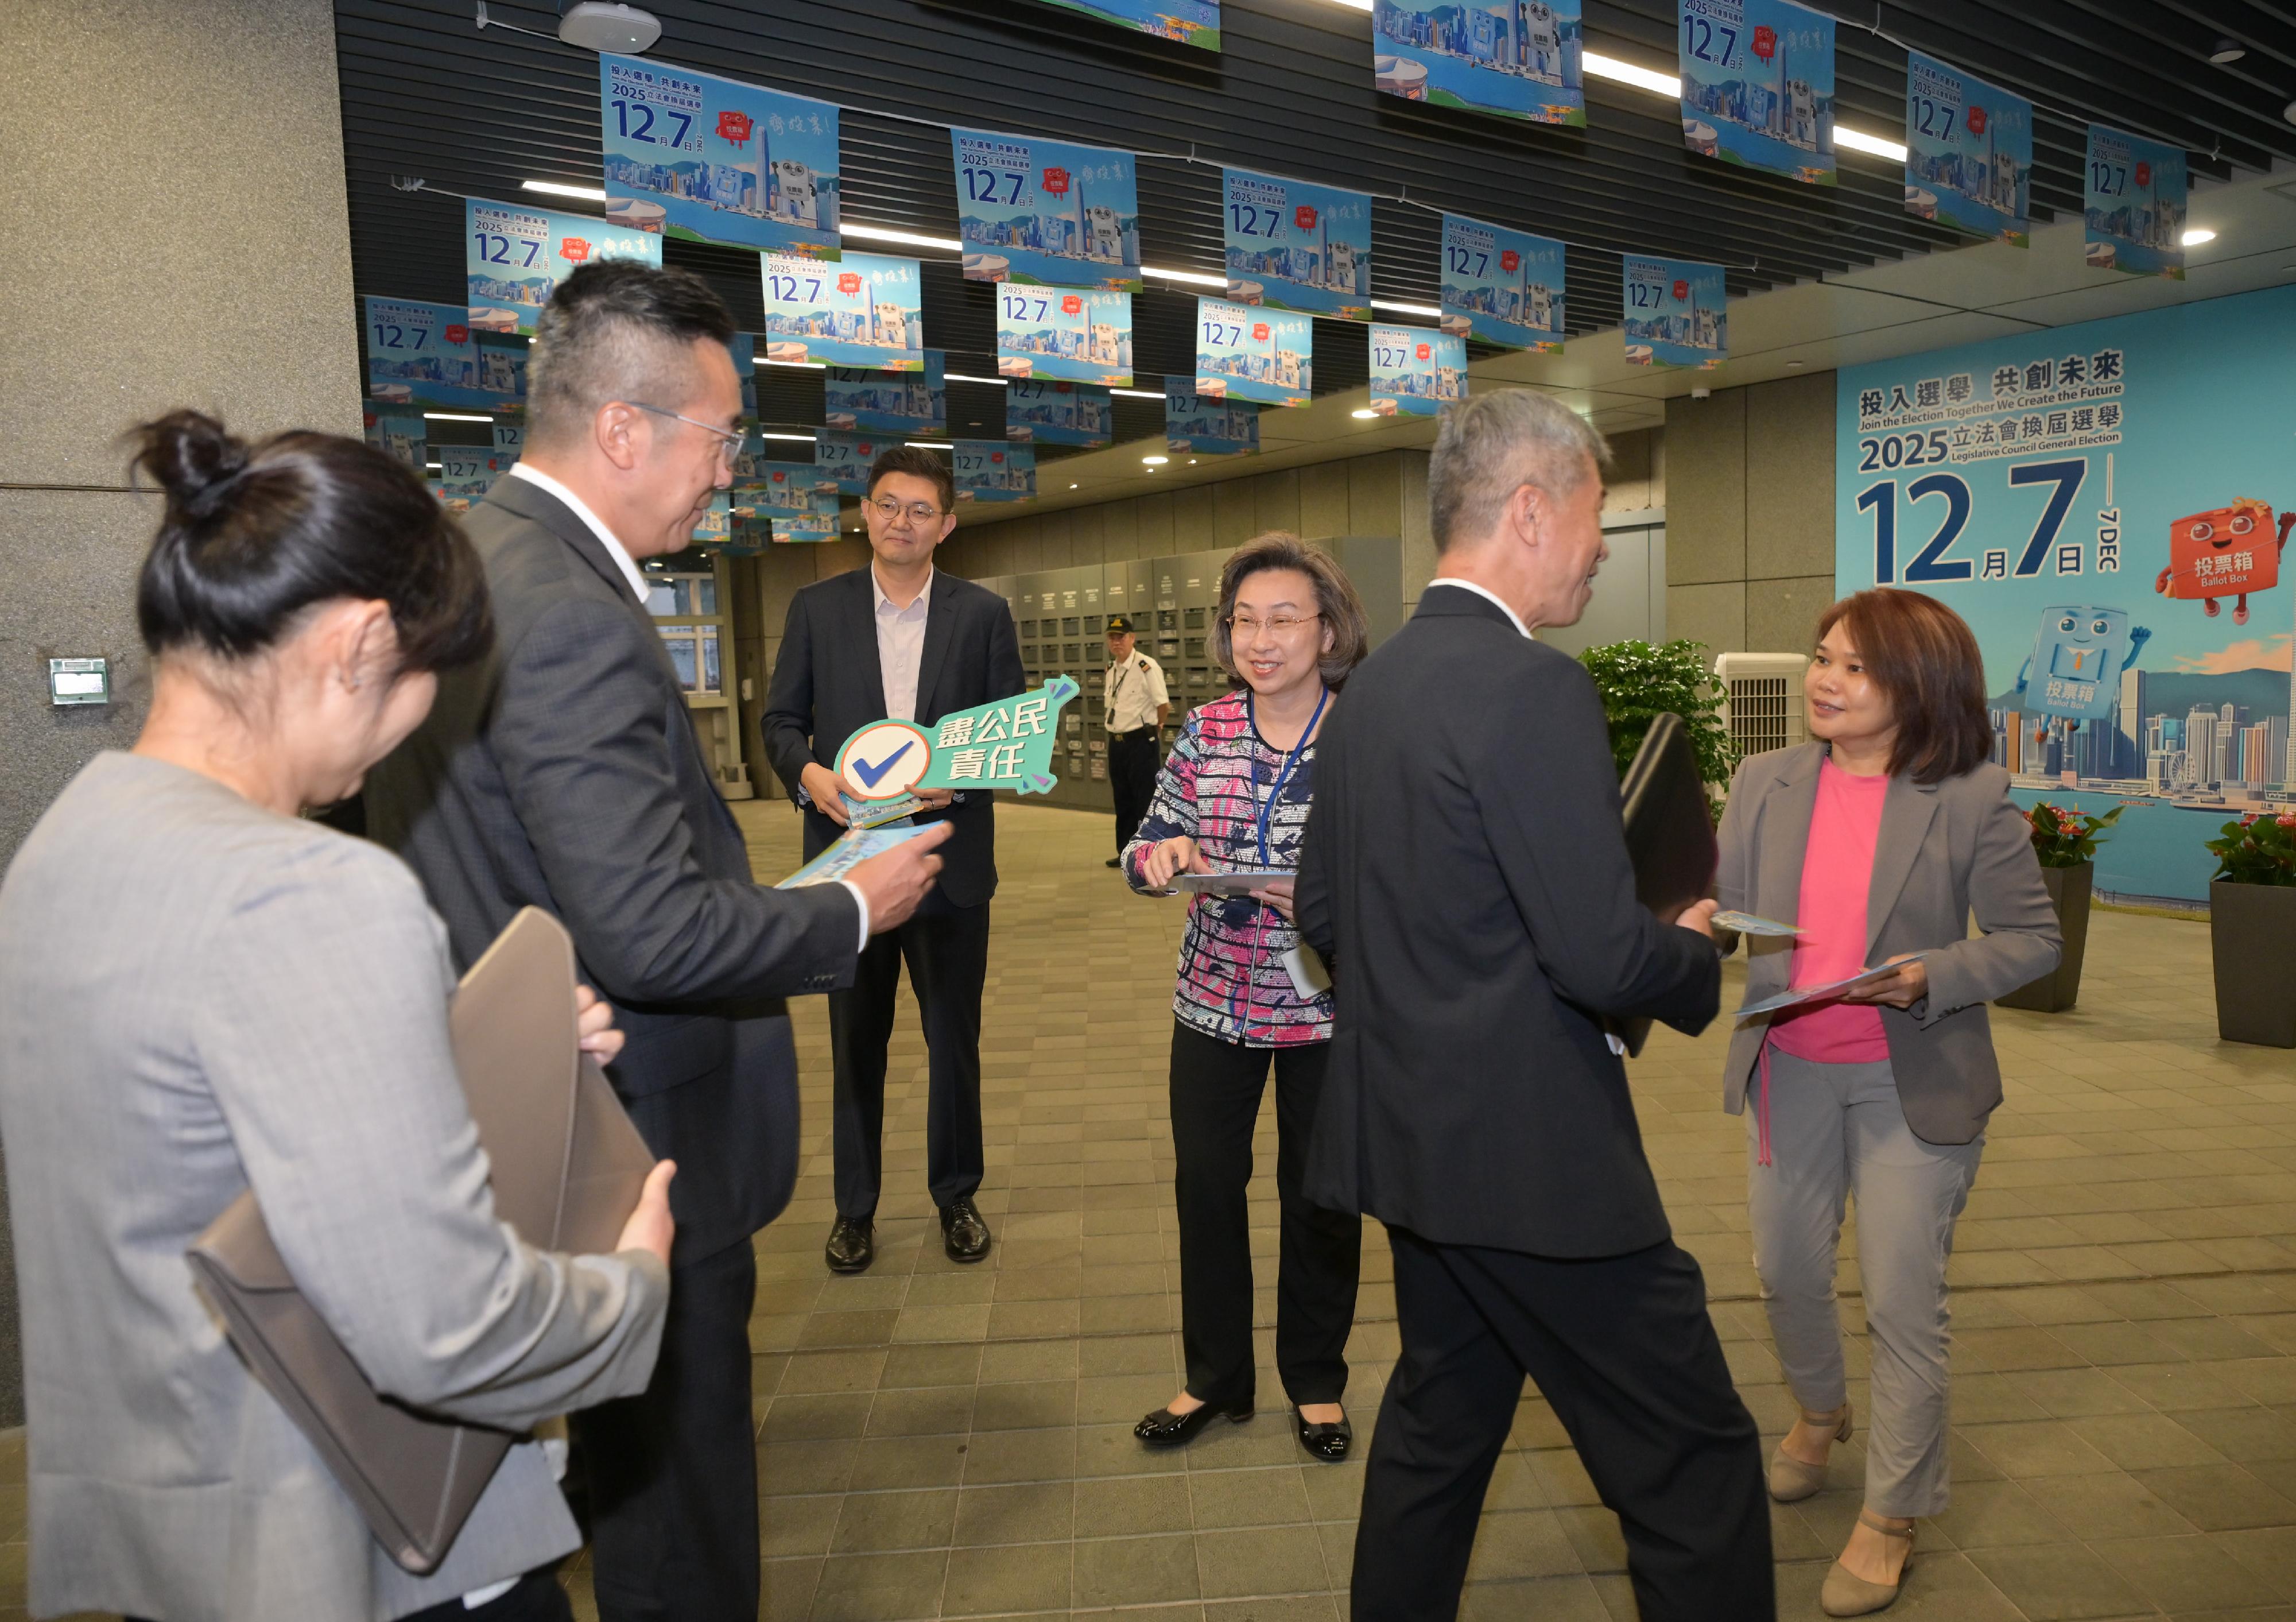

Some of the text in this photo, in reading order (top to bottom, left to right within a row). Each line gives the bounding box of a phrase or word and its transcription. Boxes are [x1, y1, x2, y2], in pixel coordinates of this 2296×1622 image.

[611, 64, 701, 94] 投入選舉 共創未來
[1860, 351, 2122, 417] 投入選舉 共創未來
[1860, 383, 2122, 431] Join the Election Together We Create the Future
[1952, 432, 2120, 462] Legislative Council General Election
[2099, 510, 2117, 570] 7 DEC
[2194, 551, 2254, 578] 投票箱
[2201, 574, 2248, 587] Ballot Box
[2045, 681, 2096, 702] 投票箱
[2047, 698, 2085, 710] Ballot Box
[936, 698, 1048, 750] 盡公民
[947, 742, 1026, 780] 責任
